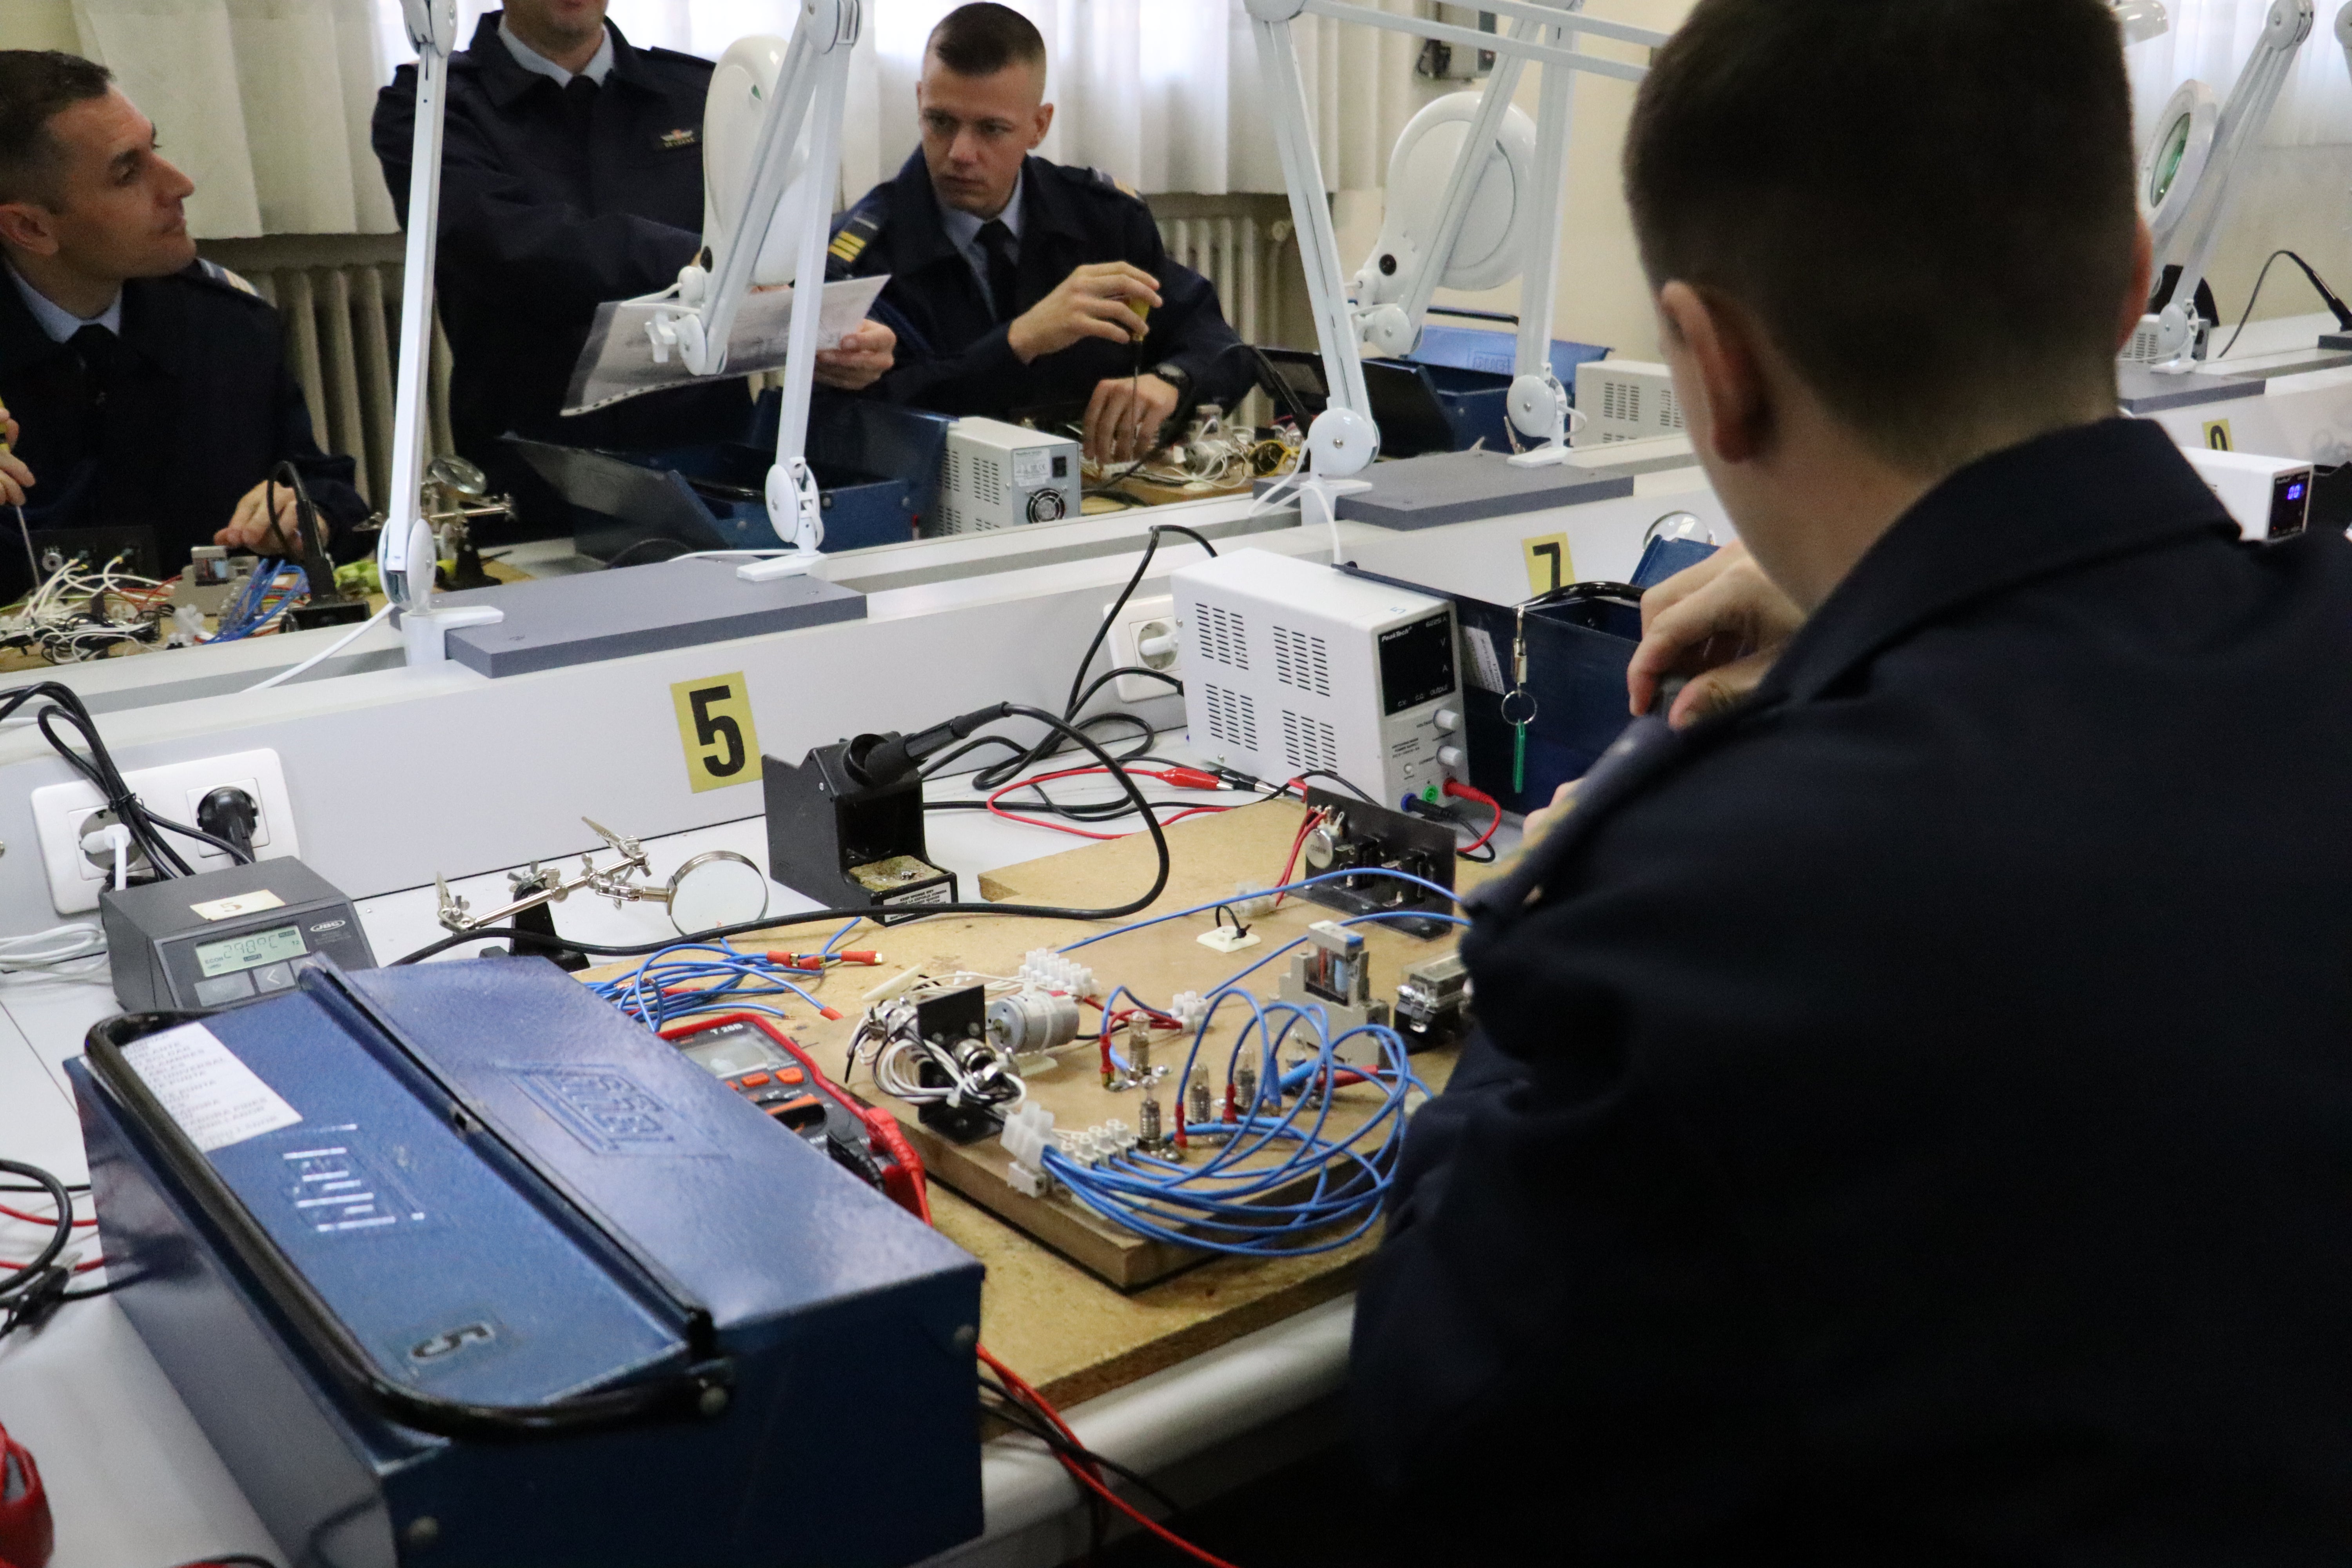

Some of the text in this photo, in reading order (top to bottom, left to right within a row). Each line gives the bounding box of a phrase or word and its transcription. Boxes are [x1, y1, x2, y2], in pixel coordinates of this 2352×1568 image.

[1532, 542, 1560, 590] 7
[1440, 638, 1446, 646] V
[1442, 664, 1448, 673] A
[689, 685, 745, 777] 5
[220, 902, 243, 912] 5
